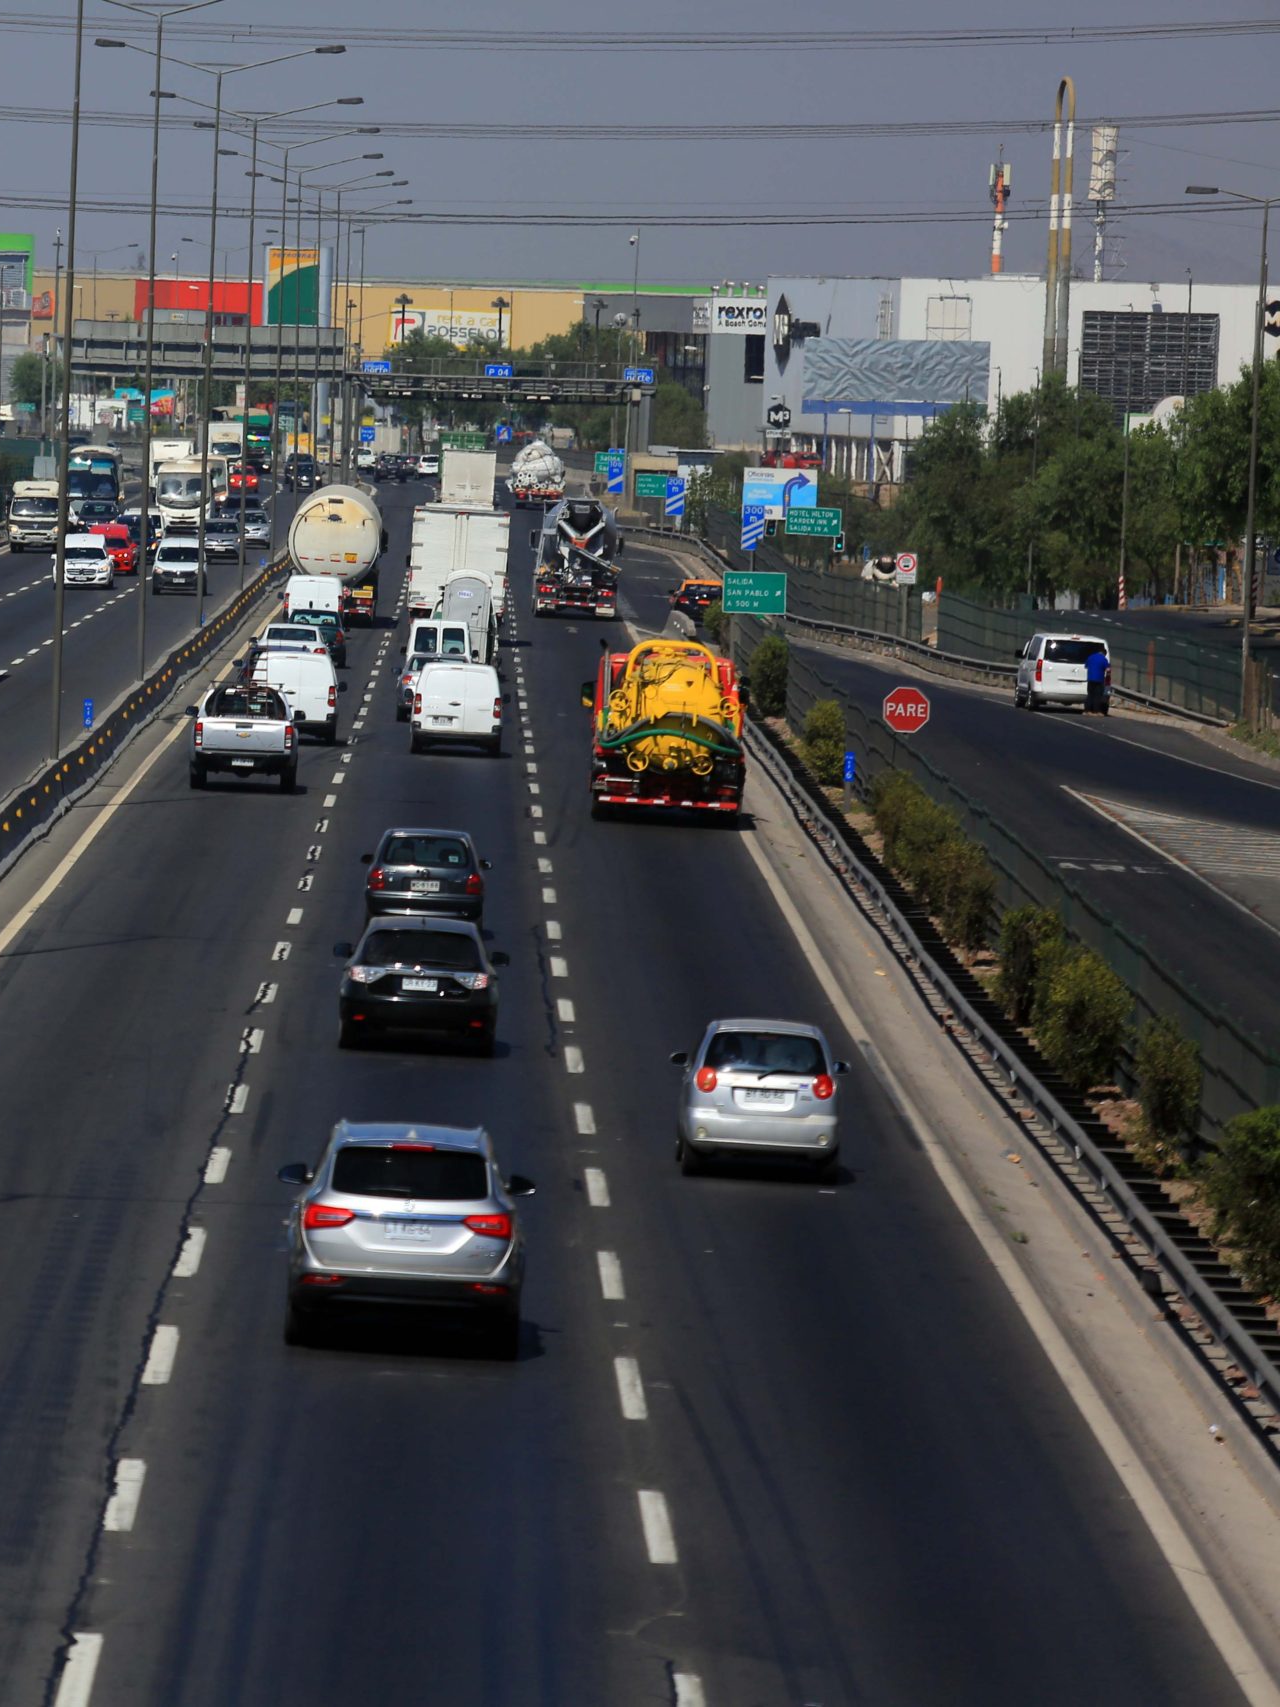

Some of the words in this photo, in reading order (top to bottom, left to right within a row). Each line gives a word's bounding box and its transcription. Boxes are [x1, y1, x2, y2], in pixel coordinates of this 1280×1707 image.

[437, 315, 462, 325] rent
[467, 317, 476, 326] a
[480, 318, 500, 327] ca
[668, 478, 683, 486] 200
[744, 506, 763, 514] 300
[745, 589, 769, 597] PABLO
[886, 702, 926, 718] PARE
